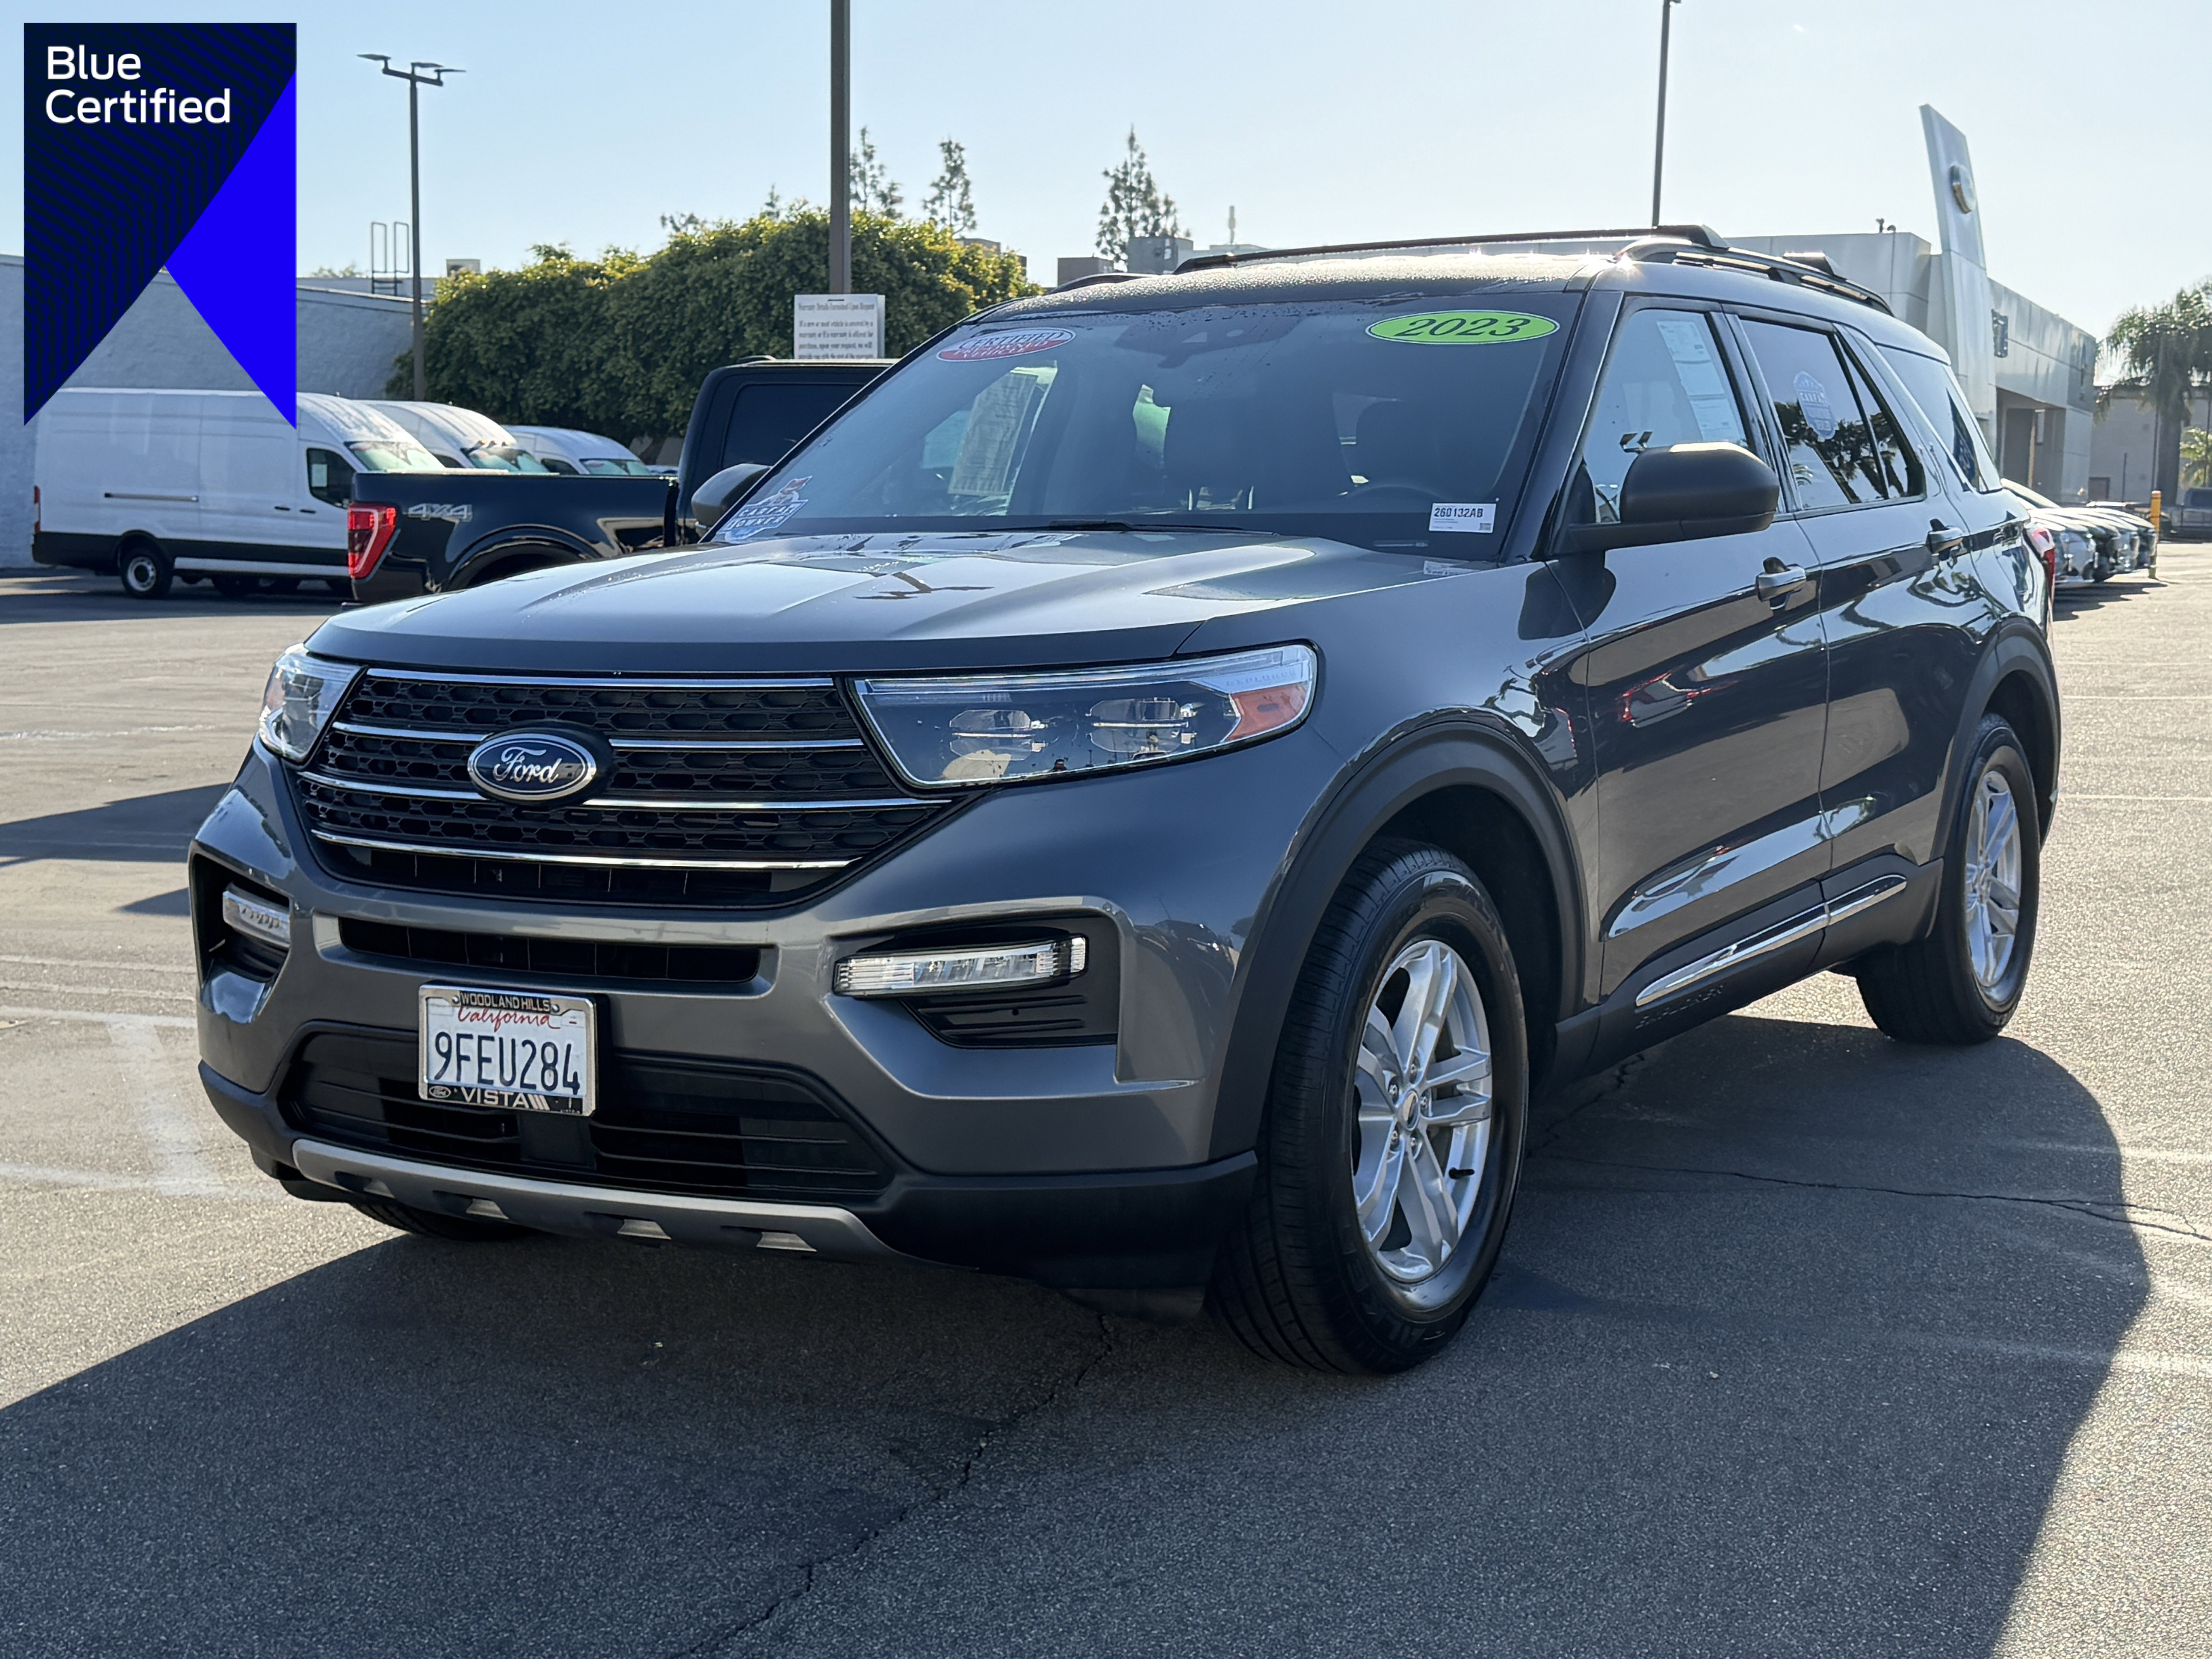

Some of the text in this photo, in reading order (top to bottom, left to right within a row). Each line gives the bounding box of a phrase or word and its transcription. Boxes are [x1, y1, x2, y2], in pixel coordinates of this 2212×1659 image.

[1394, 318, 1531, 337] 2023
[958, 331, 1064, 349] CERTIFIED
[493, 747, 562, 783] Ford
[460, 992, 550, 1012] WOODLAND HILLS
[457, 1006, 561, 1032] California
[434, 1031, 580, 1095] 9FEU284
[461, 1087, 529, 1108] VISTA
